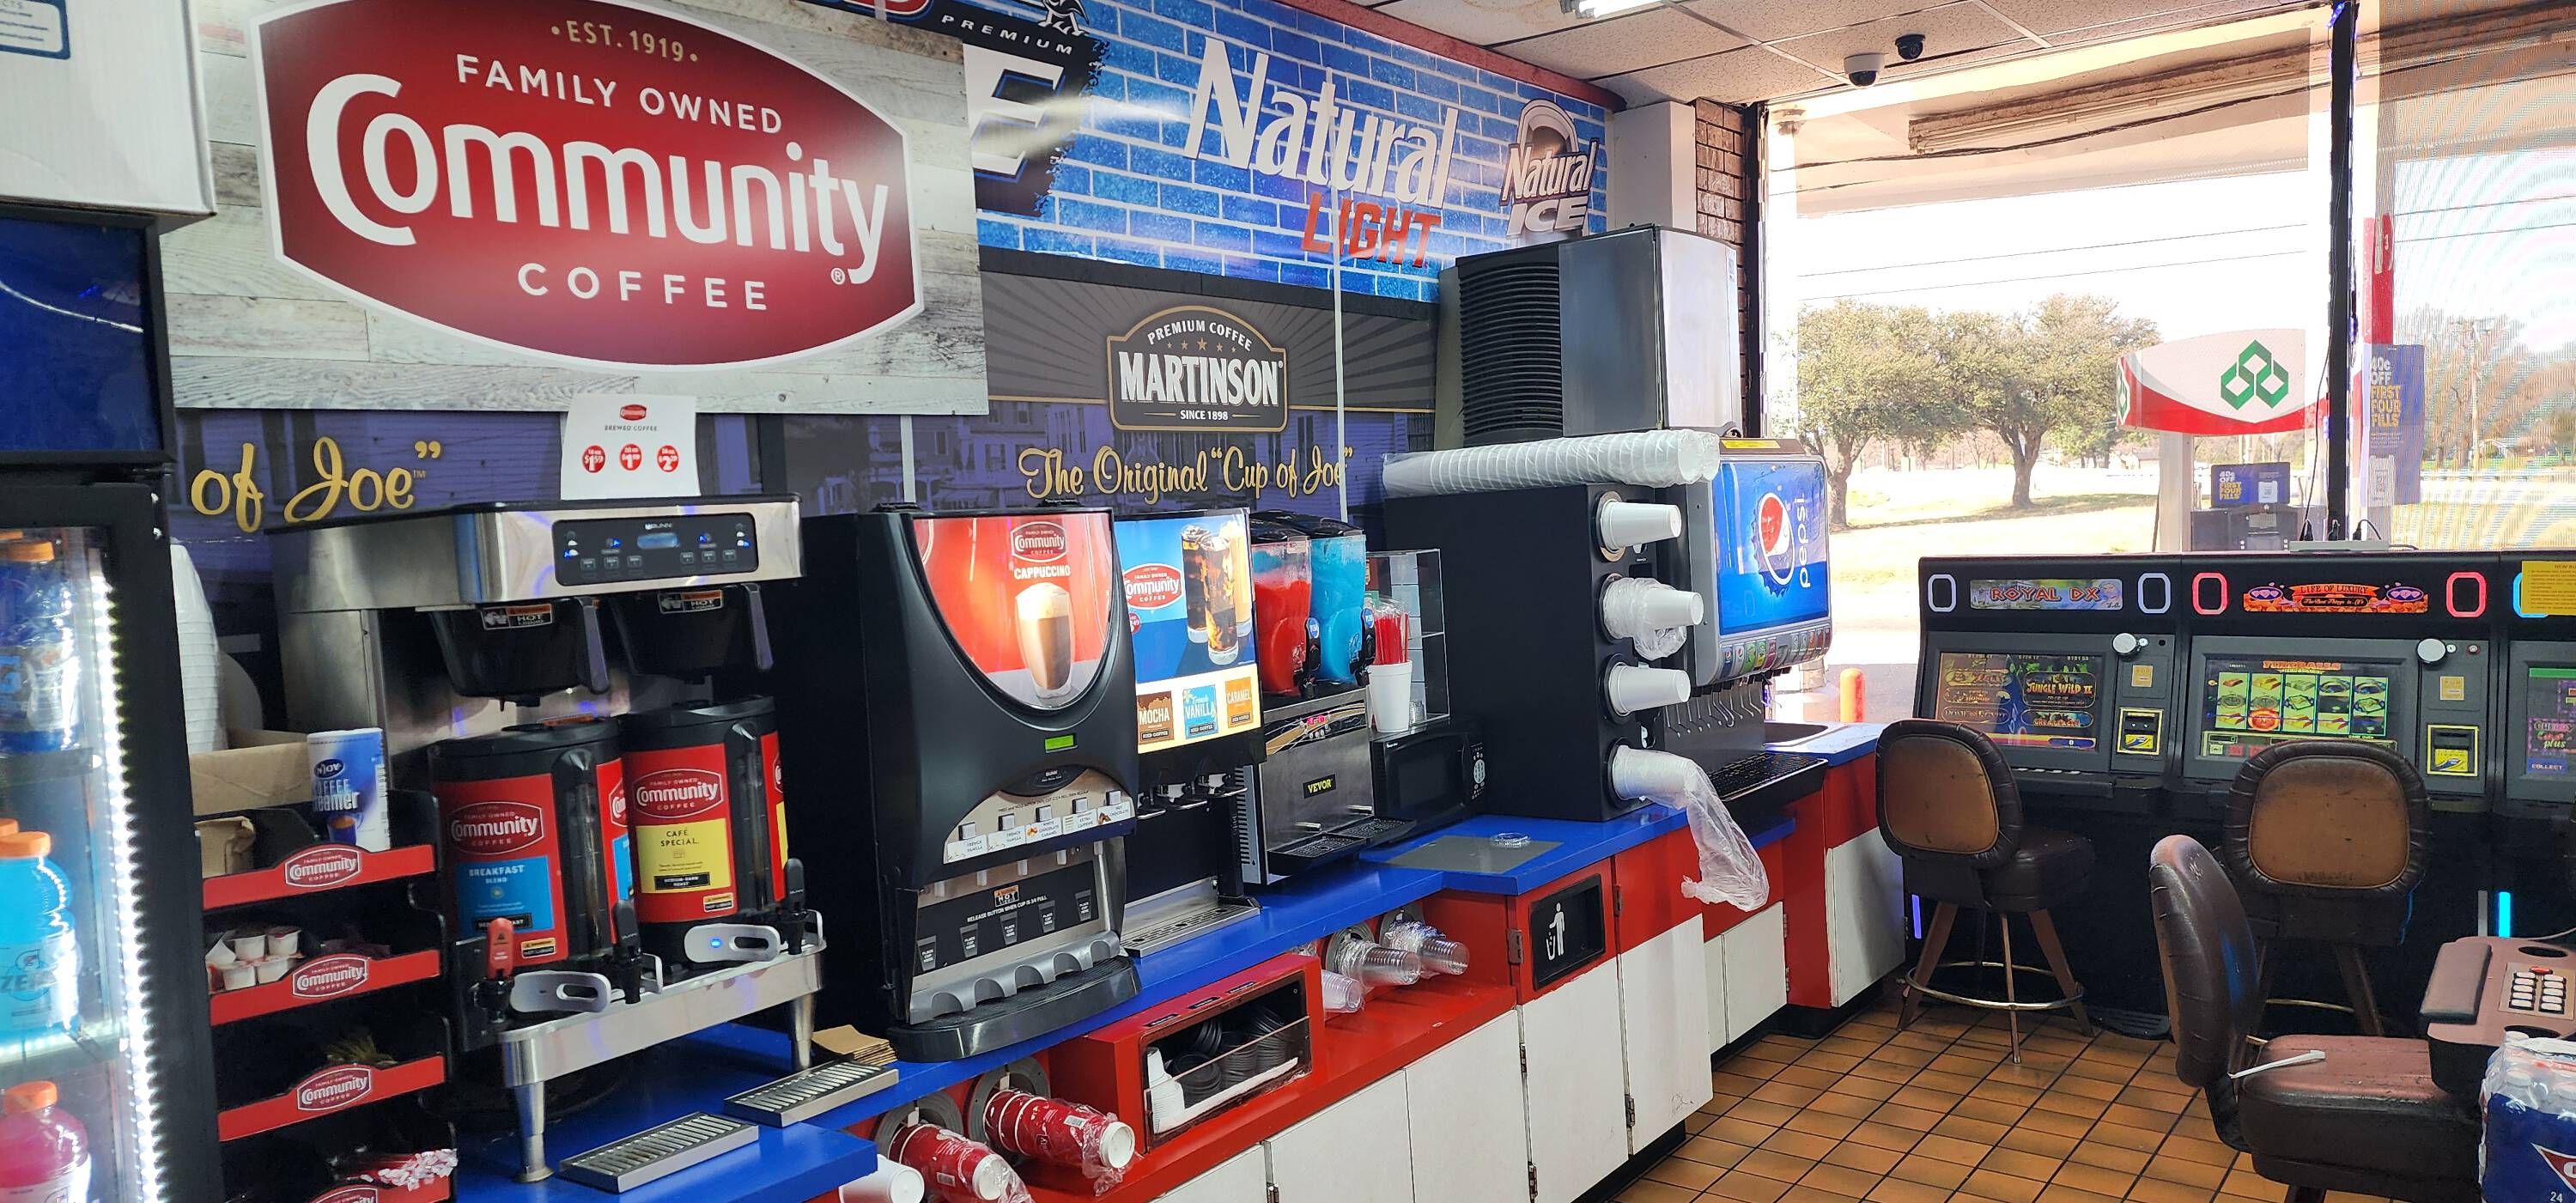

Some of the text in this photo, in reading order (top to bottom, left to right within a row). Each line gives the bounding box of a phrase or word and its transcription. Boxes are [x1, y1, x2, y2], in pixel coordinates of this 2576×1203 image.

[629, 29, 685, 62] 1919
[941, 15, 1072, 56] PREMIUM
[456, 53, 782, 134] FAMILY OWNED
[1183, 36, 1459, 210] Natural
[307, 73, 890, 285] Community
[1500, 139, 1598, 203] Natural
[1506, 196, 1589, 236] ICE
[1301, 191, 1443, 269] LIGHT
[518, 263, 768, 311] COFFEE
[1147, 320, 1253, 352] PREMIUM COFFEE
[1118, 351, 1279, 407] MARTINSON
[1180, 410, 1229, 421] SINCE 1898
[1018, 447, 1084, 499] The
[1093, 444, 1208, 506] Original
[1211, 445, 1269, 499] "Cup
[1276, 448, 1298, 498] of
[191, 442, 264, 533] of
[1014, 533, 1065, 552] Community
[1794, 496, 1812, 589] pepsi
[1014, 565, 1071, 580] CAPPUCCINO
[1991, 587, 2101, 602] ROYAL DX
[2300, 586, 2321, 594] LIFE
[2336, 585, 2369, 594] LUXURY
[1227, 689, 1251, 704] CARAMEL
[2026, 682, 2057, 695] JUNGLE
[1139, 707, 1170, 725] MOCHA
[1185, 700, 1217, 720] VANILLA
[2543, 738, 2567, 749] plus
[635, 781, 719, 807] Community
[1307, 779, 1332, 794] VEVOR
[657, 802, 696, 811] COFFEE
[451, 816, 539, 841] Community
[665, 827, 689, 838] CAFÉ
[660, 838, 697, 848] SPECIAL
[289, 858, 357, 881] Community
[468, 864, 526, 878] BREAKFAST
[998, 892, 1016, 902] HOT
[967, 913, 987, 923] RELEASE
[987, 908, 1005, 917] BUTTON
[1018, 901, 1026, 909] CUP
[296, 966, 364, 991] Community
[301, 1076, 368, 1105] Community
[2549, 1191, 2563, 1203] 24
